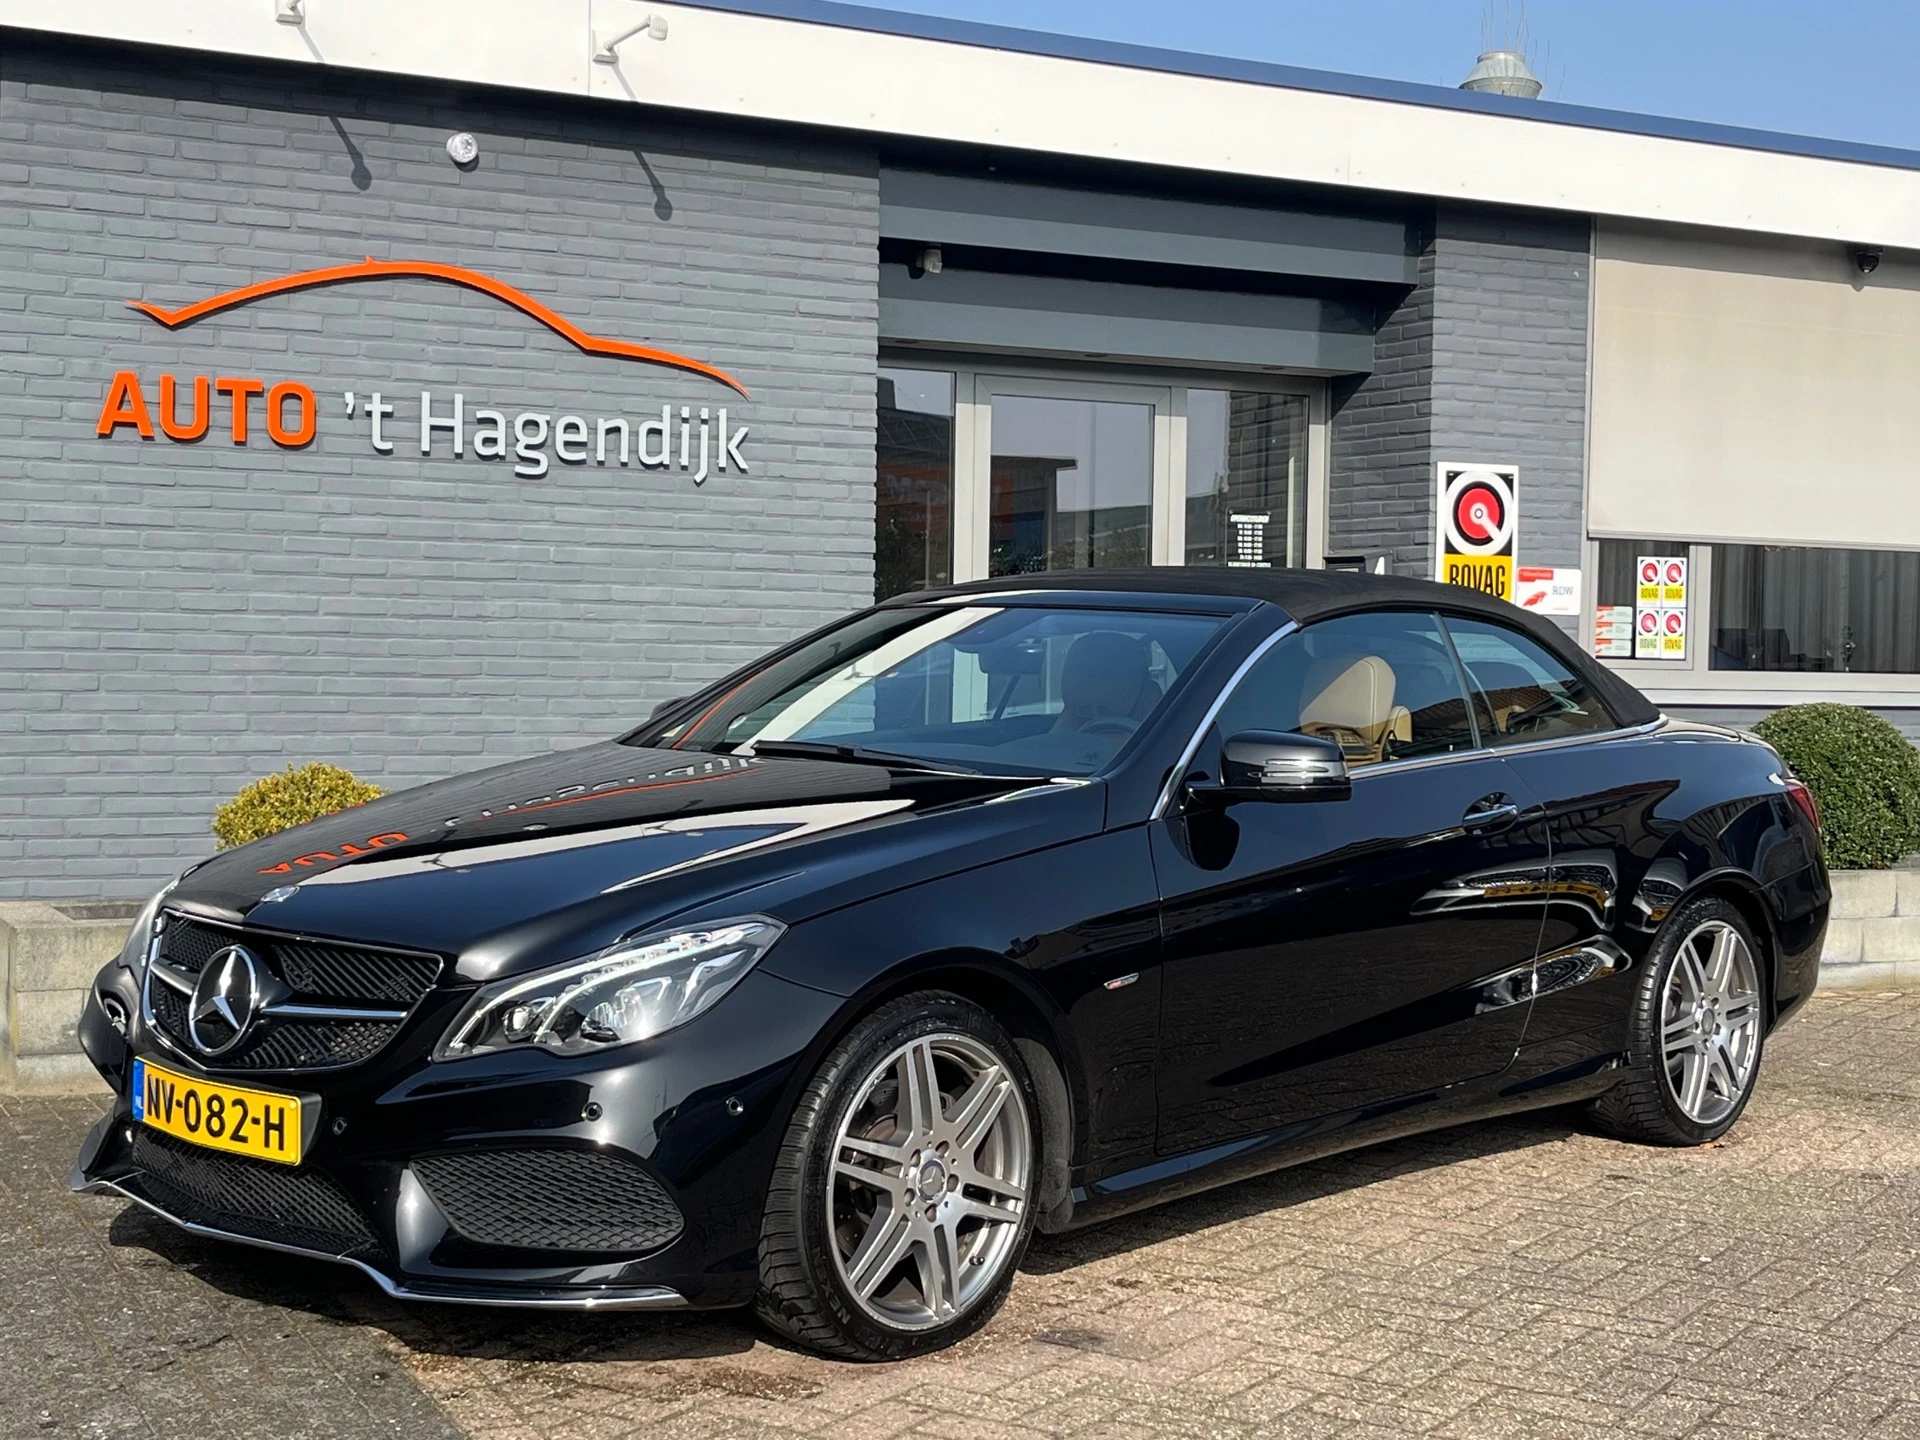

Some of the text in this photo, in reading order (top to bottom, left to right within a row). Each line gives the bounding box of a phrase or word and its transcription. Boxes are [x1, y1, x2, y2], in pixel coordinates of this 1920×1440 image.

[96, 370, 317, 446] AUTO
[420, 391, 749, 485] Hagendijk
[1449, 563, 1506, 598] BOVAG
[1551, 585, 1575, 596] RDW
[1640, 587, 1659, 599] BOVAG
[1664, 588, 1683, 600] BOVAG
[1639, 638, 1657, 649] BOVAG
[1664, 639, 1682, 650] BOVAG
[147, 1073, 285, 1151] NV-082-H
